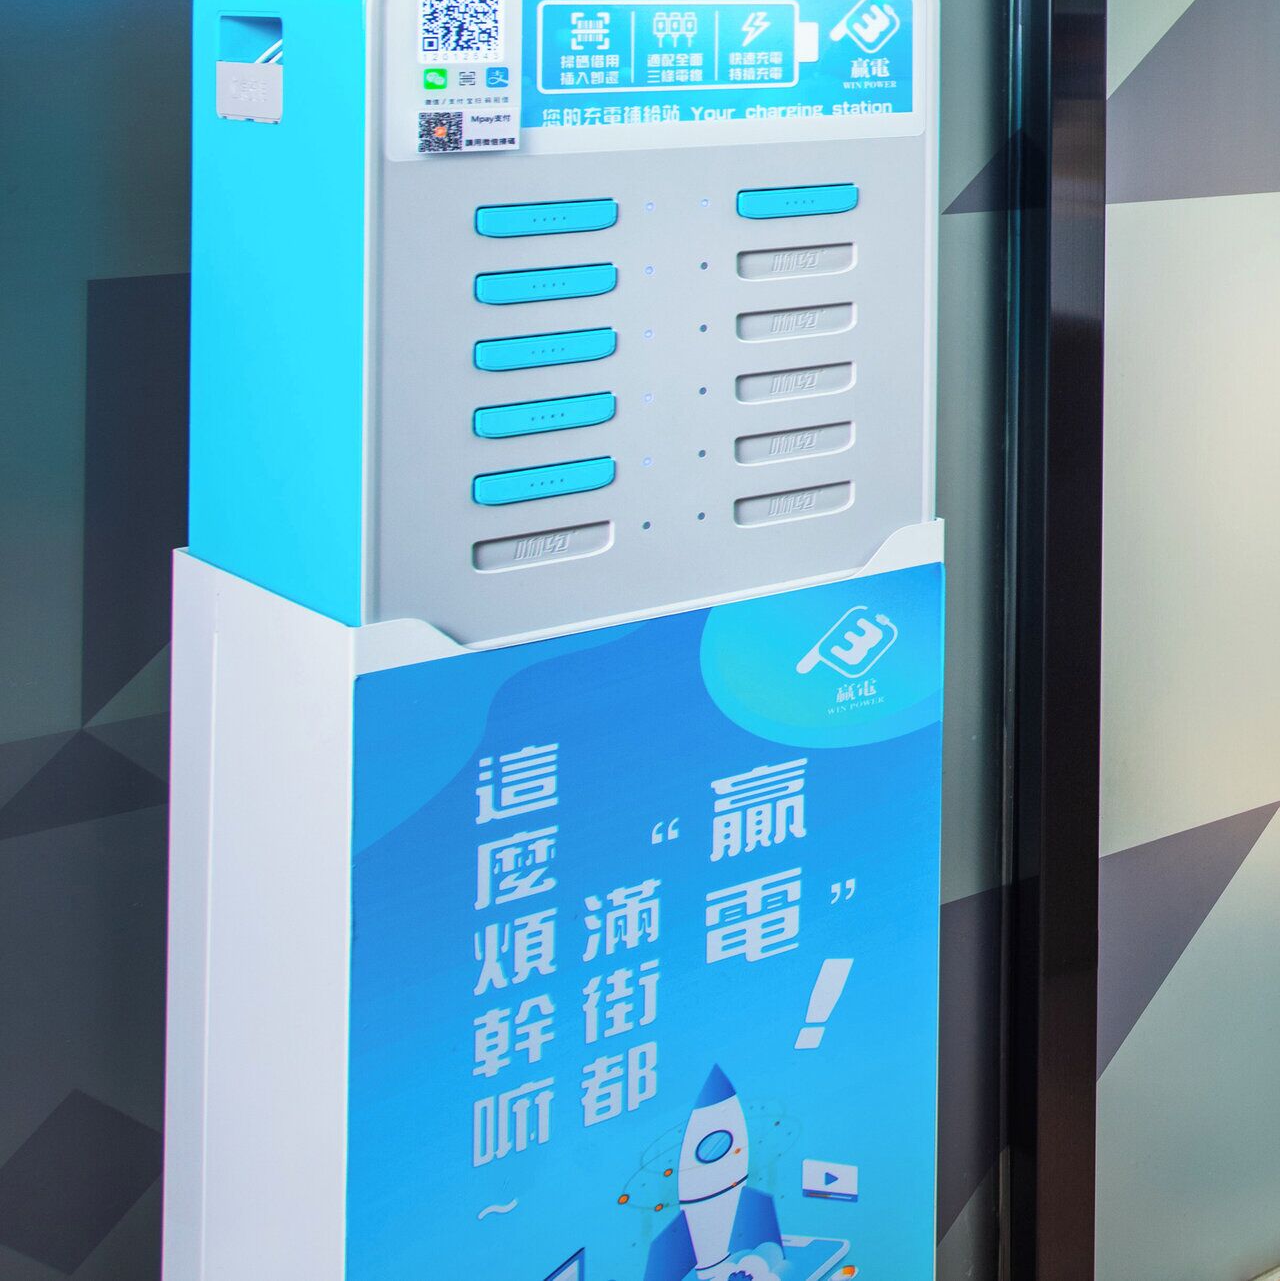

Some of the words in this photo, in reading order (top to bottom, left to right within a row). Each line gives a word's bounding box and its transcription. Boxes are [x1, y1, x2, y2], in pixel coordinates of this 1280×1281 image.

[843, 81, 862, 89] WIN
[863, 80, 897, 89] POWER
[691, 106, 736, 120] Your
[745, 103, 823, 120] charging
[832, 101, 893, 116] station
[581, 878, 662, 1126] 滿街都
